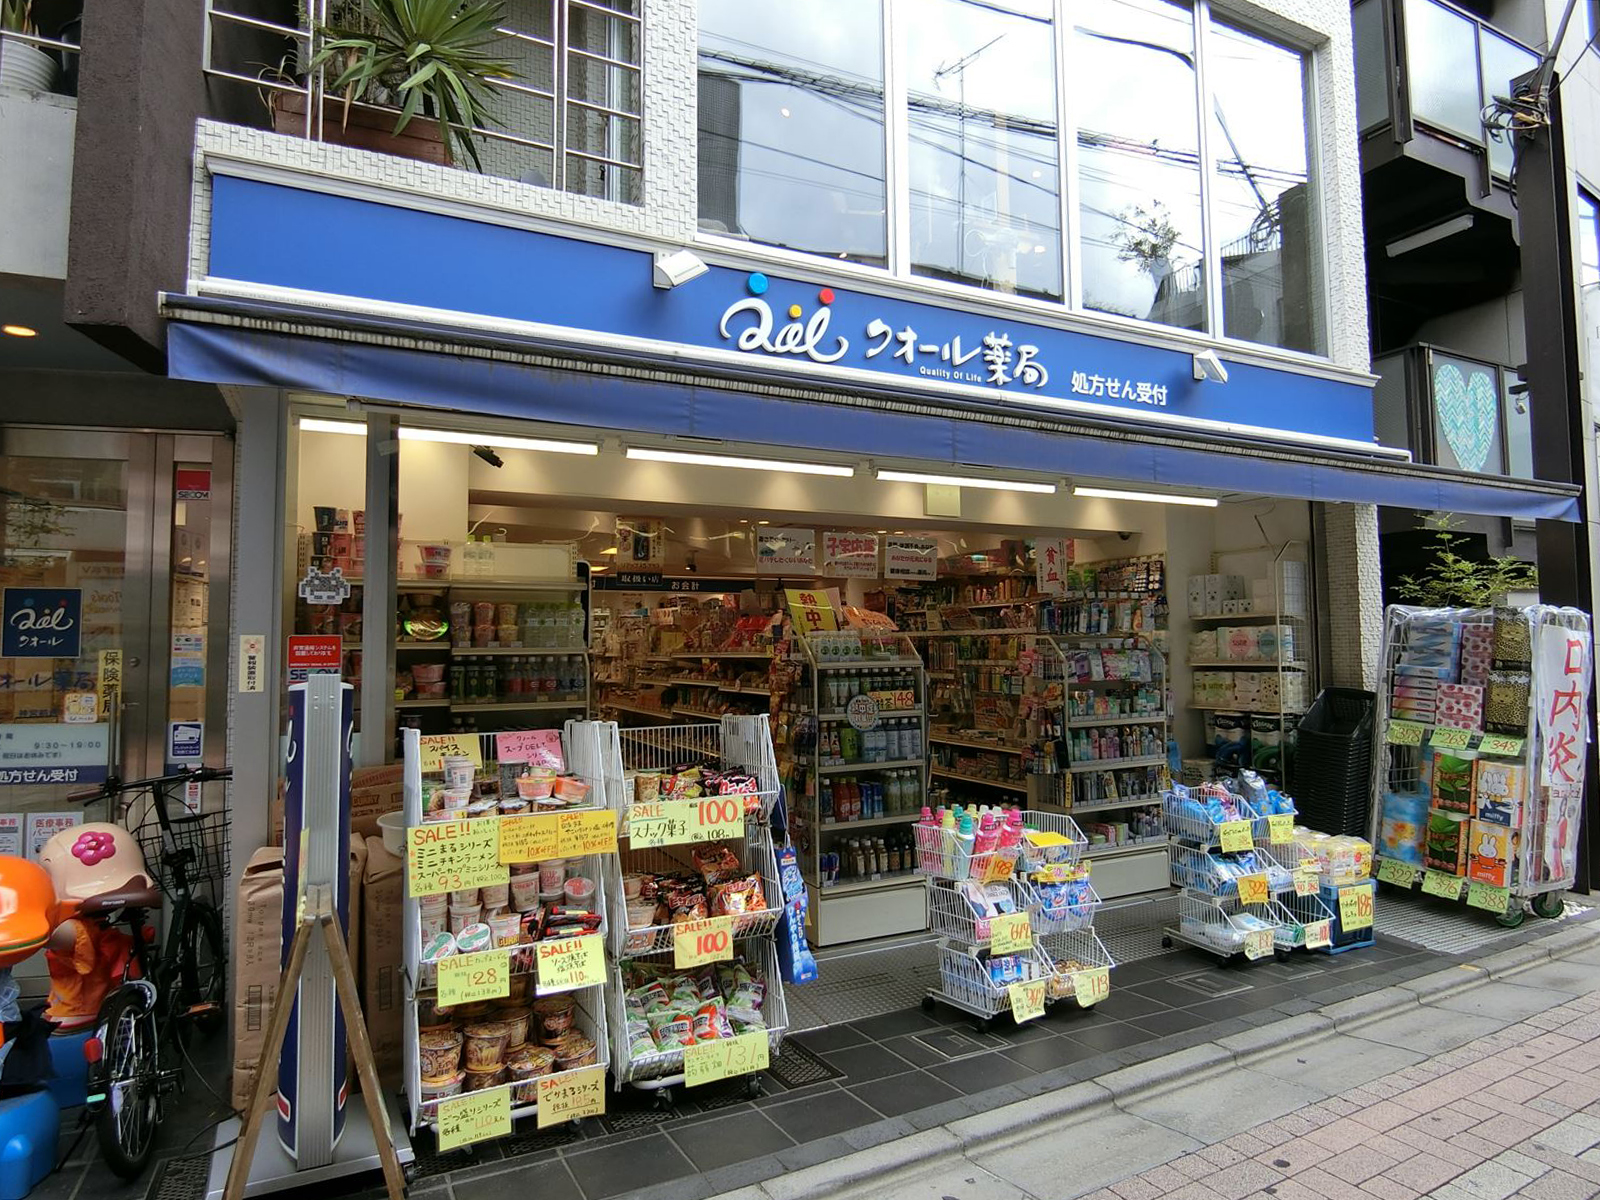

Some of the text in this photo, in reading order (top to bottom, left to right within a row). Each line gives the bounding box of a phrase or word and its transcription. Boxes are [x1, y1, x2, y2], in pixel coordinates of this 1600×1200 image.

[865, 317, 1050, 389] クオール薬局
[919, 366, 983, 383] Quality Of Life
[1070, 370, 1169, 407] 処方せん受付
[1044, 546, 1060, 583] 貧血
[671, 581, 700, 590] お会計
[799, 592, 825, 632] 熱中
[19, 635, 64, 648] クオール
[1548, 638, 1584, 782] 口内炎
[419, 736, 456, 746] SALE!!
[1443, 732, 1467, 747] 268
[1490, 739, 1518, 752] 348
[430, 744, 460, 753] スパイス
[632, 805, 665, 819] SALE
[1485, 811, 1504, 821] miffy
[414, 820, 471, 846] SALE!!
[633, 819, 688, 838] スナック菓子
[417, 838, 494, 859] ミニまるシリーズ
[417, 852, 497, 869] ミニチキンラーメン
[1386, 866, 1413, 884] 322
[1478, 890, 1507, 910] 388
[676, 920, 712, 936] SALE!!
[540, 939, 583, 960] SALE!!
[696, 930, 728, 956] 100
[439, 955, 475, 971] SALE
